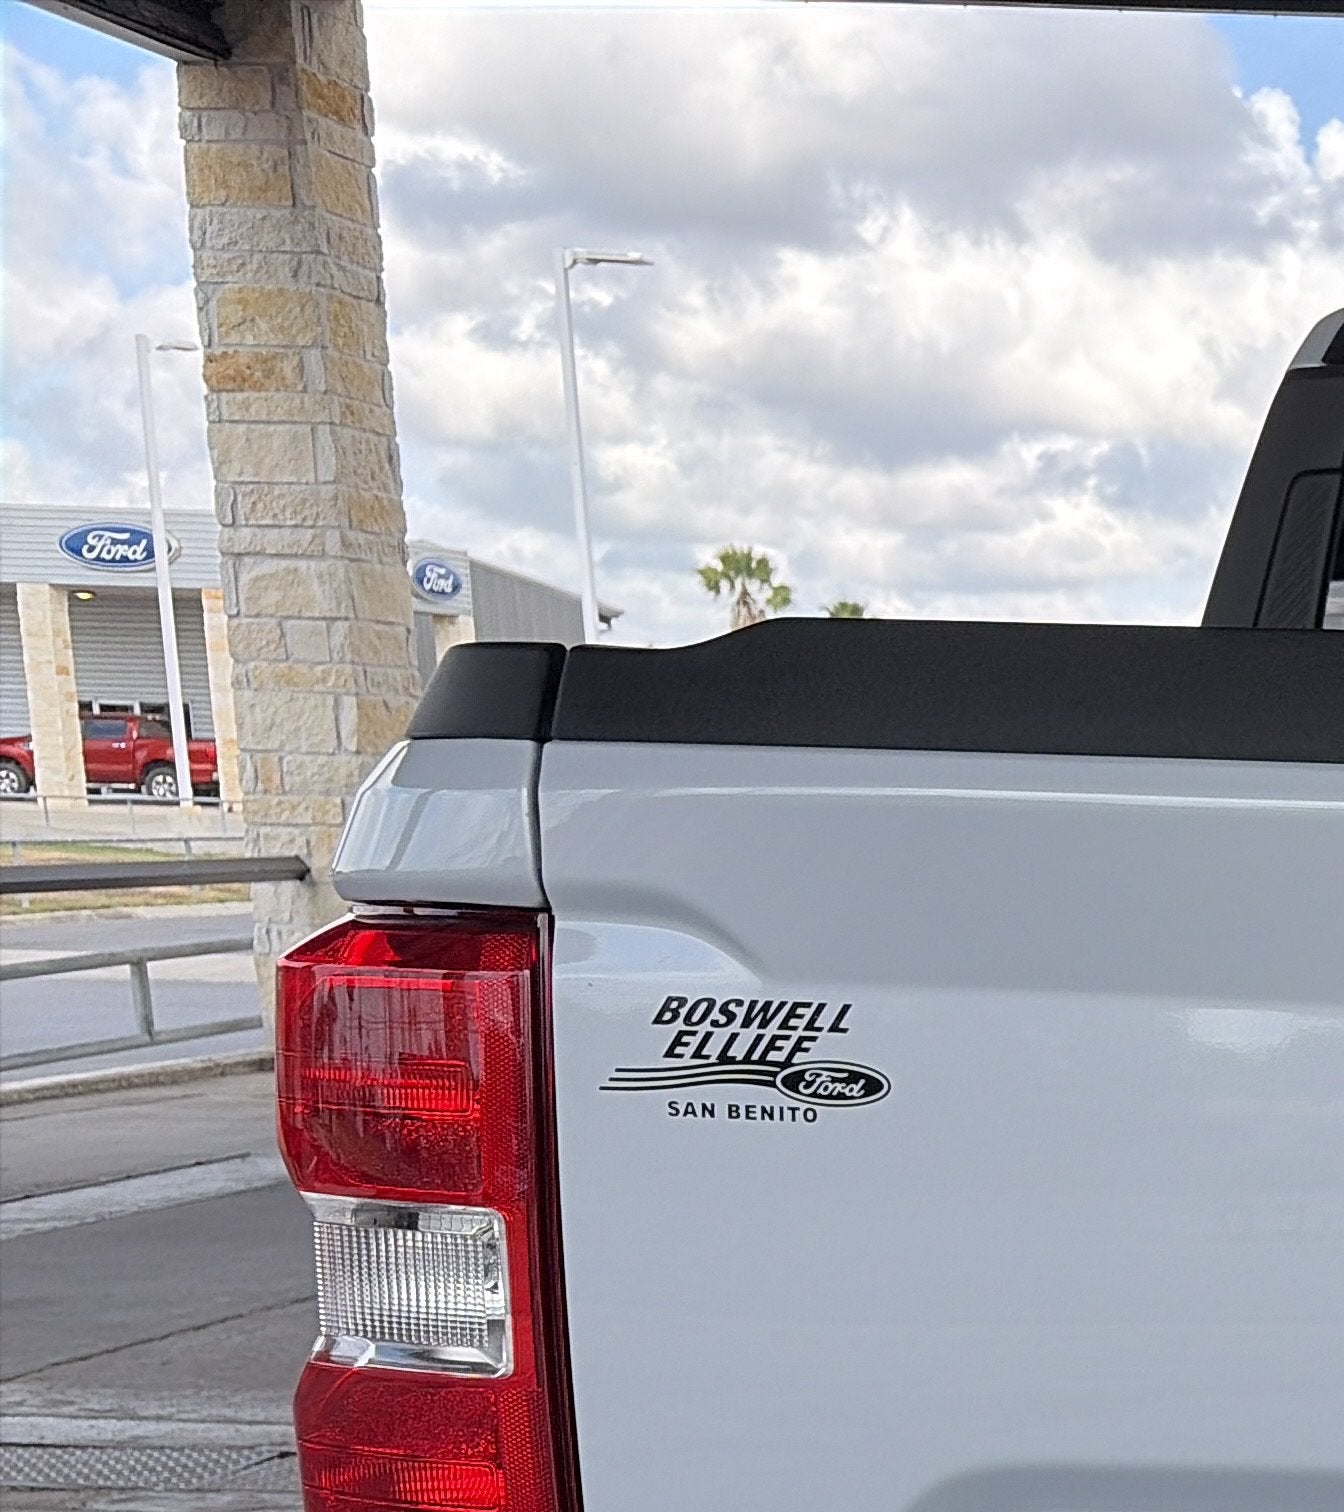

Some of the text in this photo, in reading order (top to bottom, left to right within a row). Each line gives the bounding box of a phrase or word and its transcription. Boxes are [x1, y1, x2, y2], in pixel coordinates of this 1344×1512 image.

[82, 531, 148, 560] Ford
[423, 564, 454, 593] Ford
[651, 996, 852, 1034] BOSWELL
[662, 1030, 819, 1064] ELLIFF
[799, 1069, 866, 1098] Ford
[667, 1101, 818, 1123] SAN BENITO
